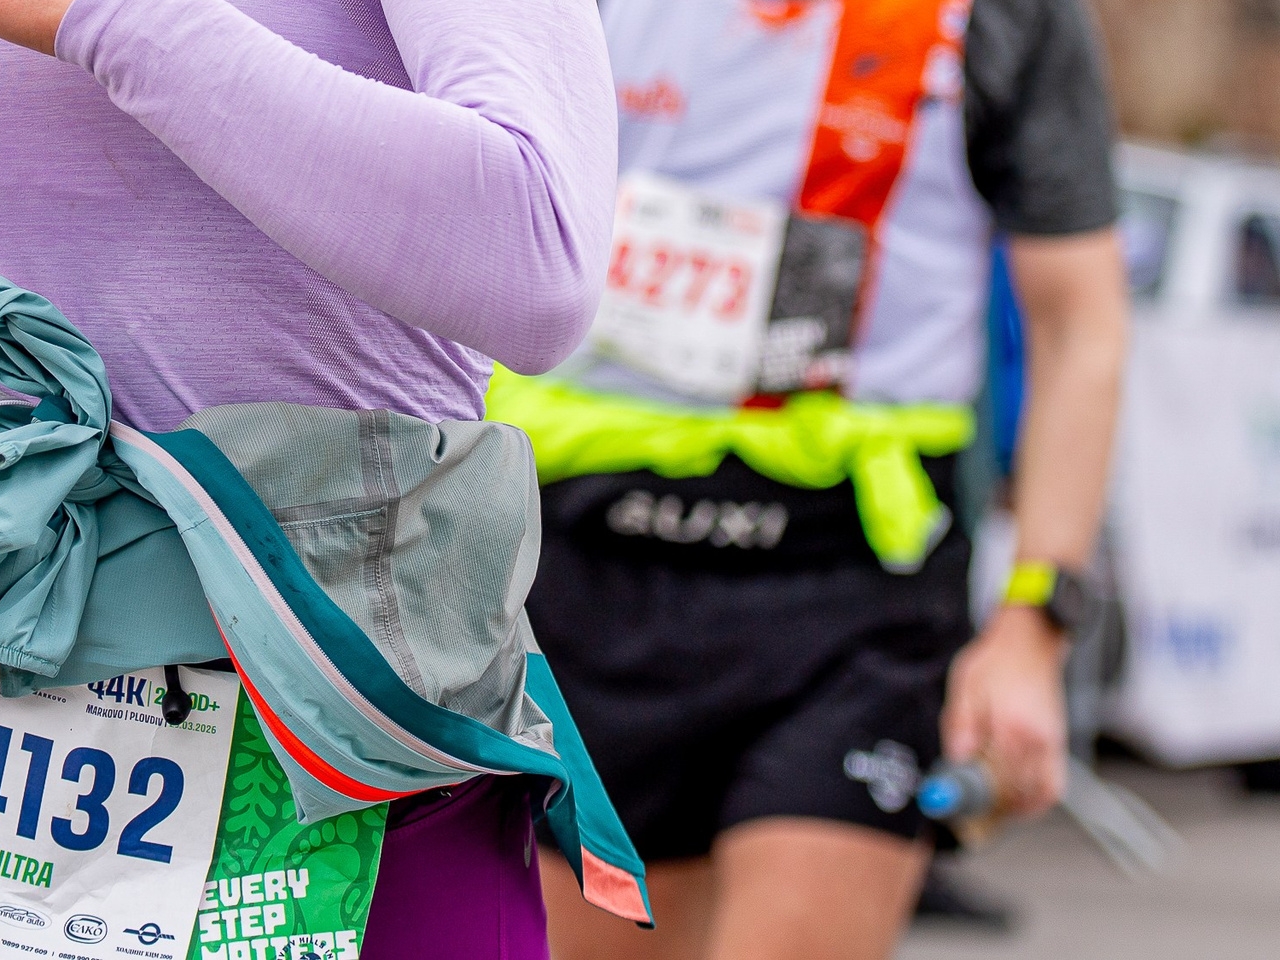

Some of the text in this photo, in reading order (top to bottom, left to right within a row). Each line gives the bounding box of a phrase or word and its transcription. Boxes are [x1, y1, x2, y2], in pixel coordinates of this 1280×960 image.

[87, 674, 147, 707] 44K
[86, 704, 217, 734] MARKOVO PLOVDIV .03.2026
[199, 868, 309, 910] EVERY
[27, 917, 46, 927] auto
[199, 903, 286, 943] STEP
